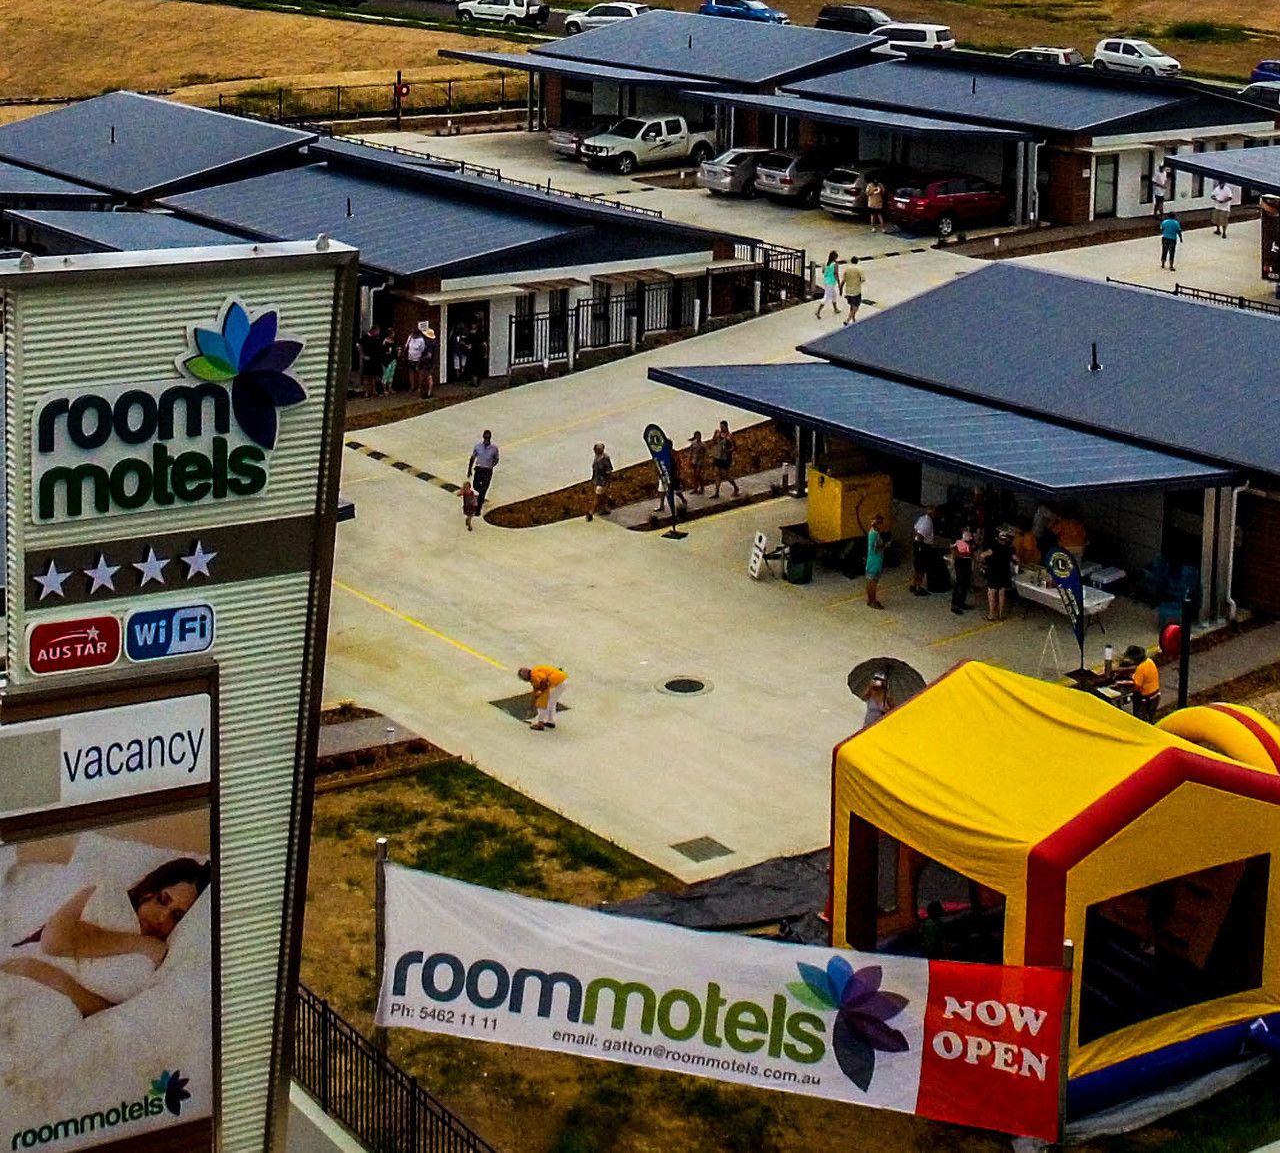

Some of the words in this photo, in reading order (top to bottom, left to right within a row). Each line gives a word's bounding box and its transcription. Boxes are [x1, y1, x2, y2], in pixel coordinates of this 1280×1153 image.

[38, 383, 230, 452] room
[38, 436, 267, 519] motels
[37, 641, 108, 662] AUSTAR
[63, 728, 205, 783] vacancy
[390, 1003, 415, 1019] Ph:
[419, 1006, 455, 1024] 5462
[460, 1013, 476, 1026] 11
[482, 1016, 498, 1031] 11
[391, 950, 827, 1065] roommotels
[942, 996, 1048, 1037] NOW
[552, 1029, 599, 1047] email:
[602, 1037, 821, 1086] gatton@roommotels.com.au
[932, 1030, 1050, 1081] OPEN
[11, 1095, 165, 1151] roommotels
